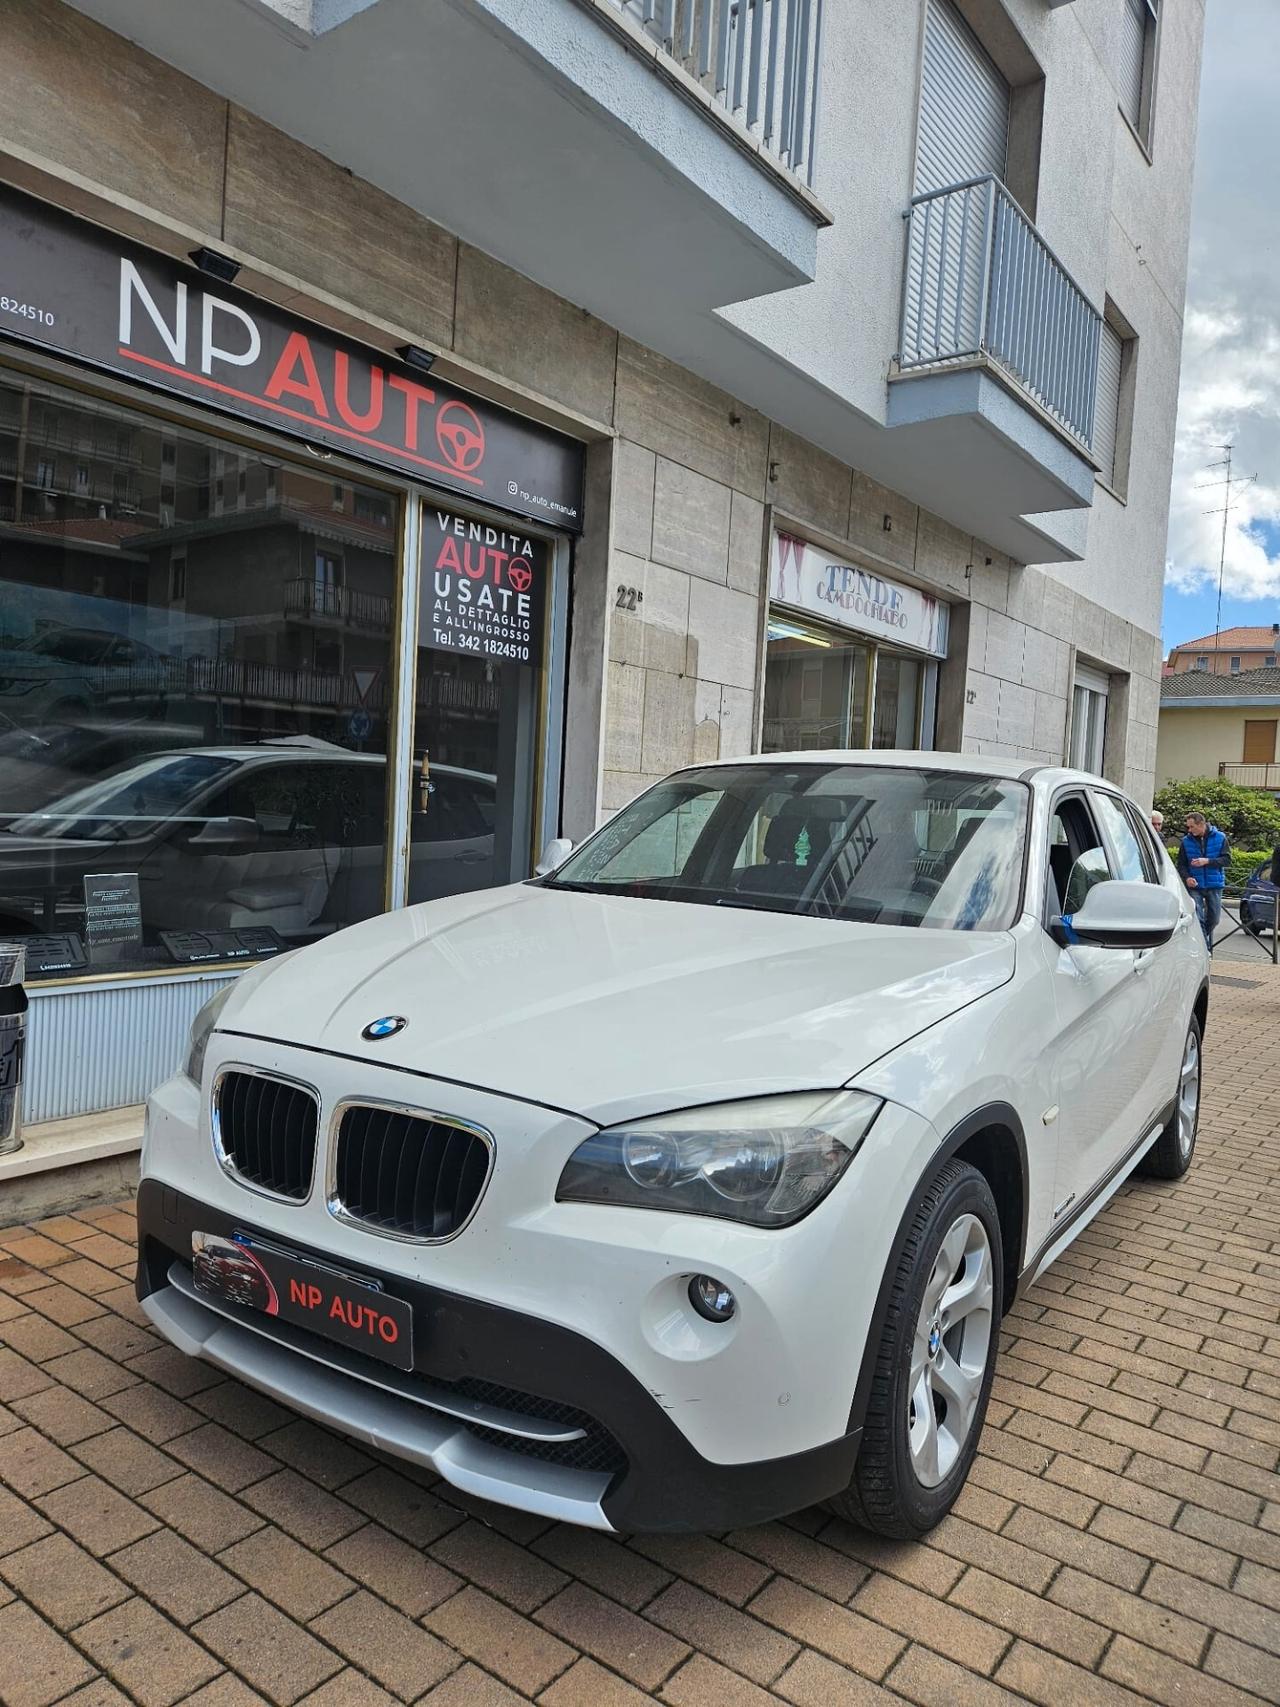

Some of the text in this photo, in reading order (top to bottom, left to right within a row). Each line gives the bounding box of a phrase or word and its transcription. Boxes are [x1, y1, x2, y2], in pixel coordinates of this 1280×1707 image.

[119, 257, 485, 472] NP AUTO
[437, 512, 533, 558] VENDITA
[435, 536, 533, 592] AUTO
[434, 572, 531, 618] USATE
[434, 599, 530, 630] AL DETTAGLIO
[433, 613, 530, 642] E ALL'INGROSSO
[433, 628, 529, 661] Tel. 342 1824510
[290, 1279, 398, 1344] NP AUTO
